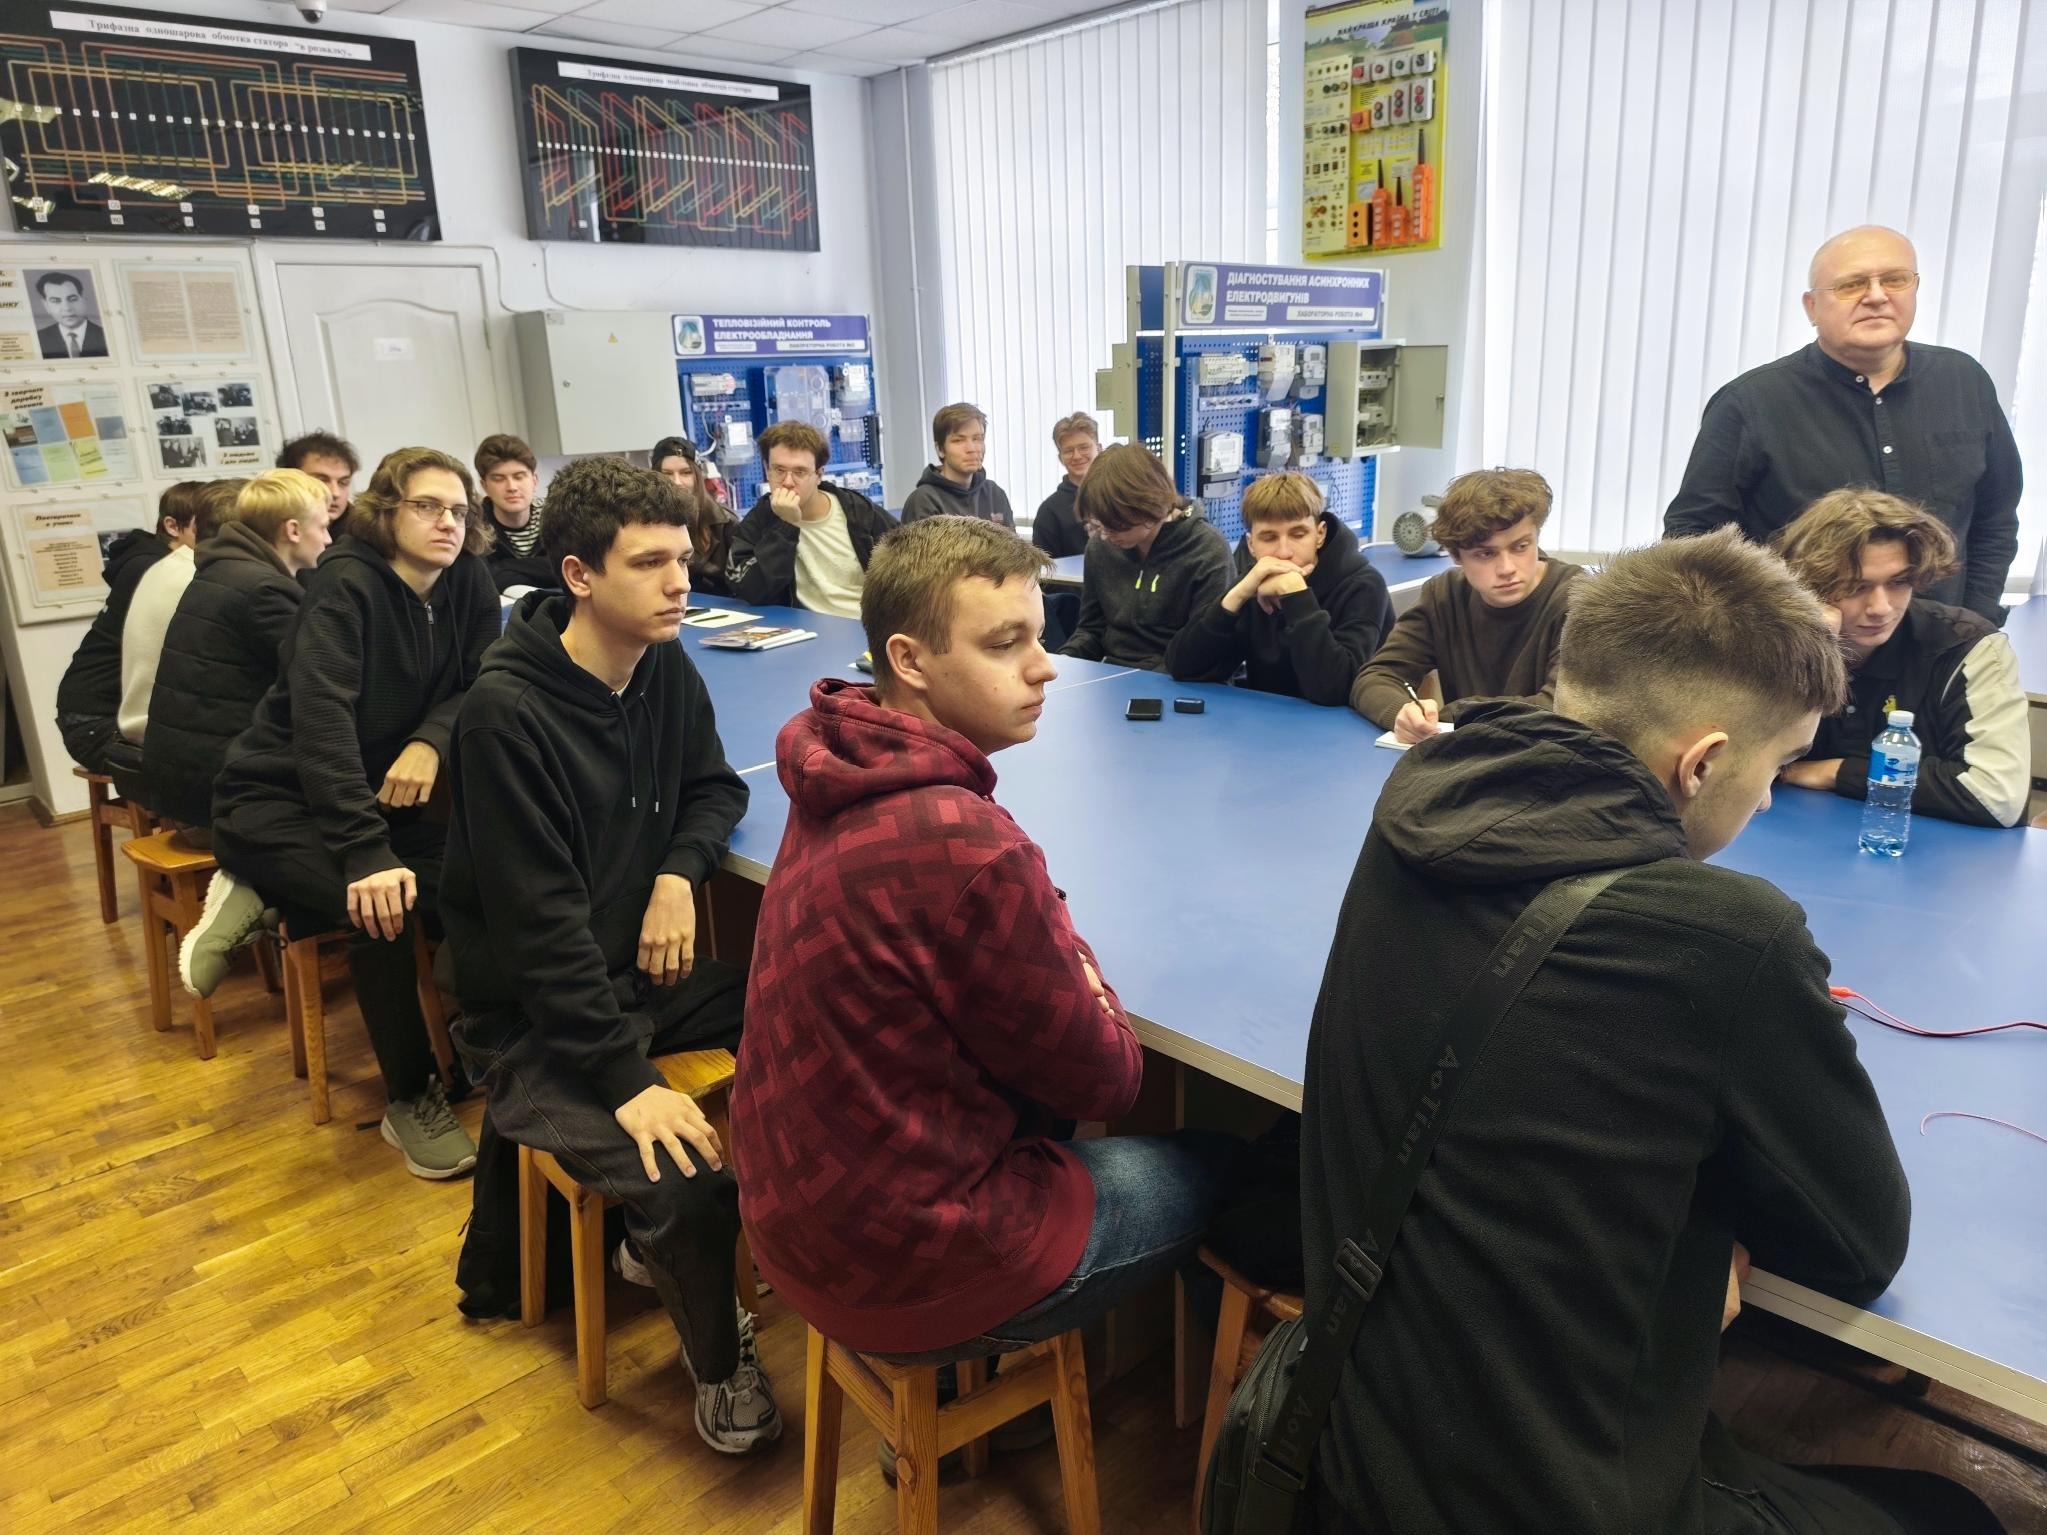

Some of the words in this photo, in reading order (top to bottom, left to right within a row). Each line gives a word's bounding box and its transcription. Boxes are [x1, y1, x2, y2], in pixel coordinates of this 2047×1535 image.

[89, 19, 140, 33] Трифазна
[145, 26, 206, 39] одношарова
[211, 31, 250, 43] обмотка
[253, 37, 289, 48] статора
[1227, 272, 1308, 286] ДІАГНОСТУВАННЯ
[1308, 275, 1370, 288] АСИНХРОННИХ
[1226, 290, 1310, 304] ЕЛЕКТРОДВИГУНІВ
[712, 318, 785, 328] ТЕПЛОВІЗІЙНИЙ
[787, 319, 831, 328] КОНТРОЛЬ
[714, 331, 813, 341] ЕЛЕКТРООБЛАДНАННЯ
[1396, 1043, 1461, 1167] AoTian
